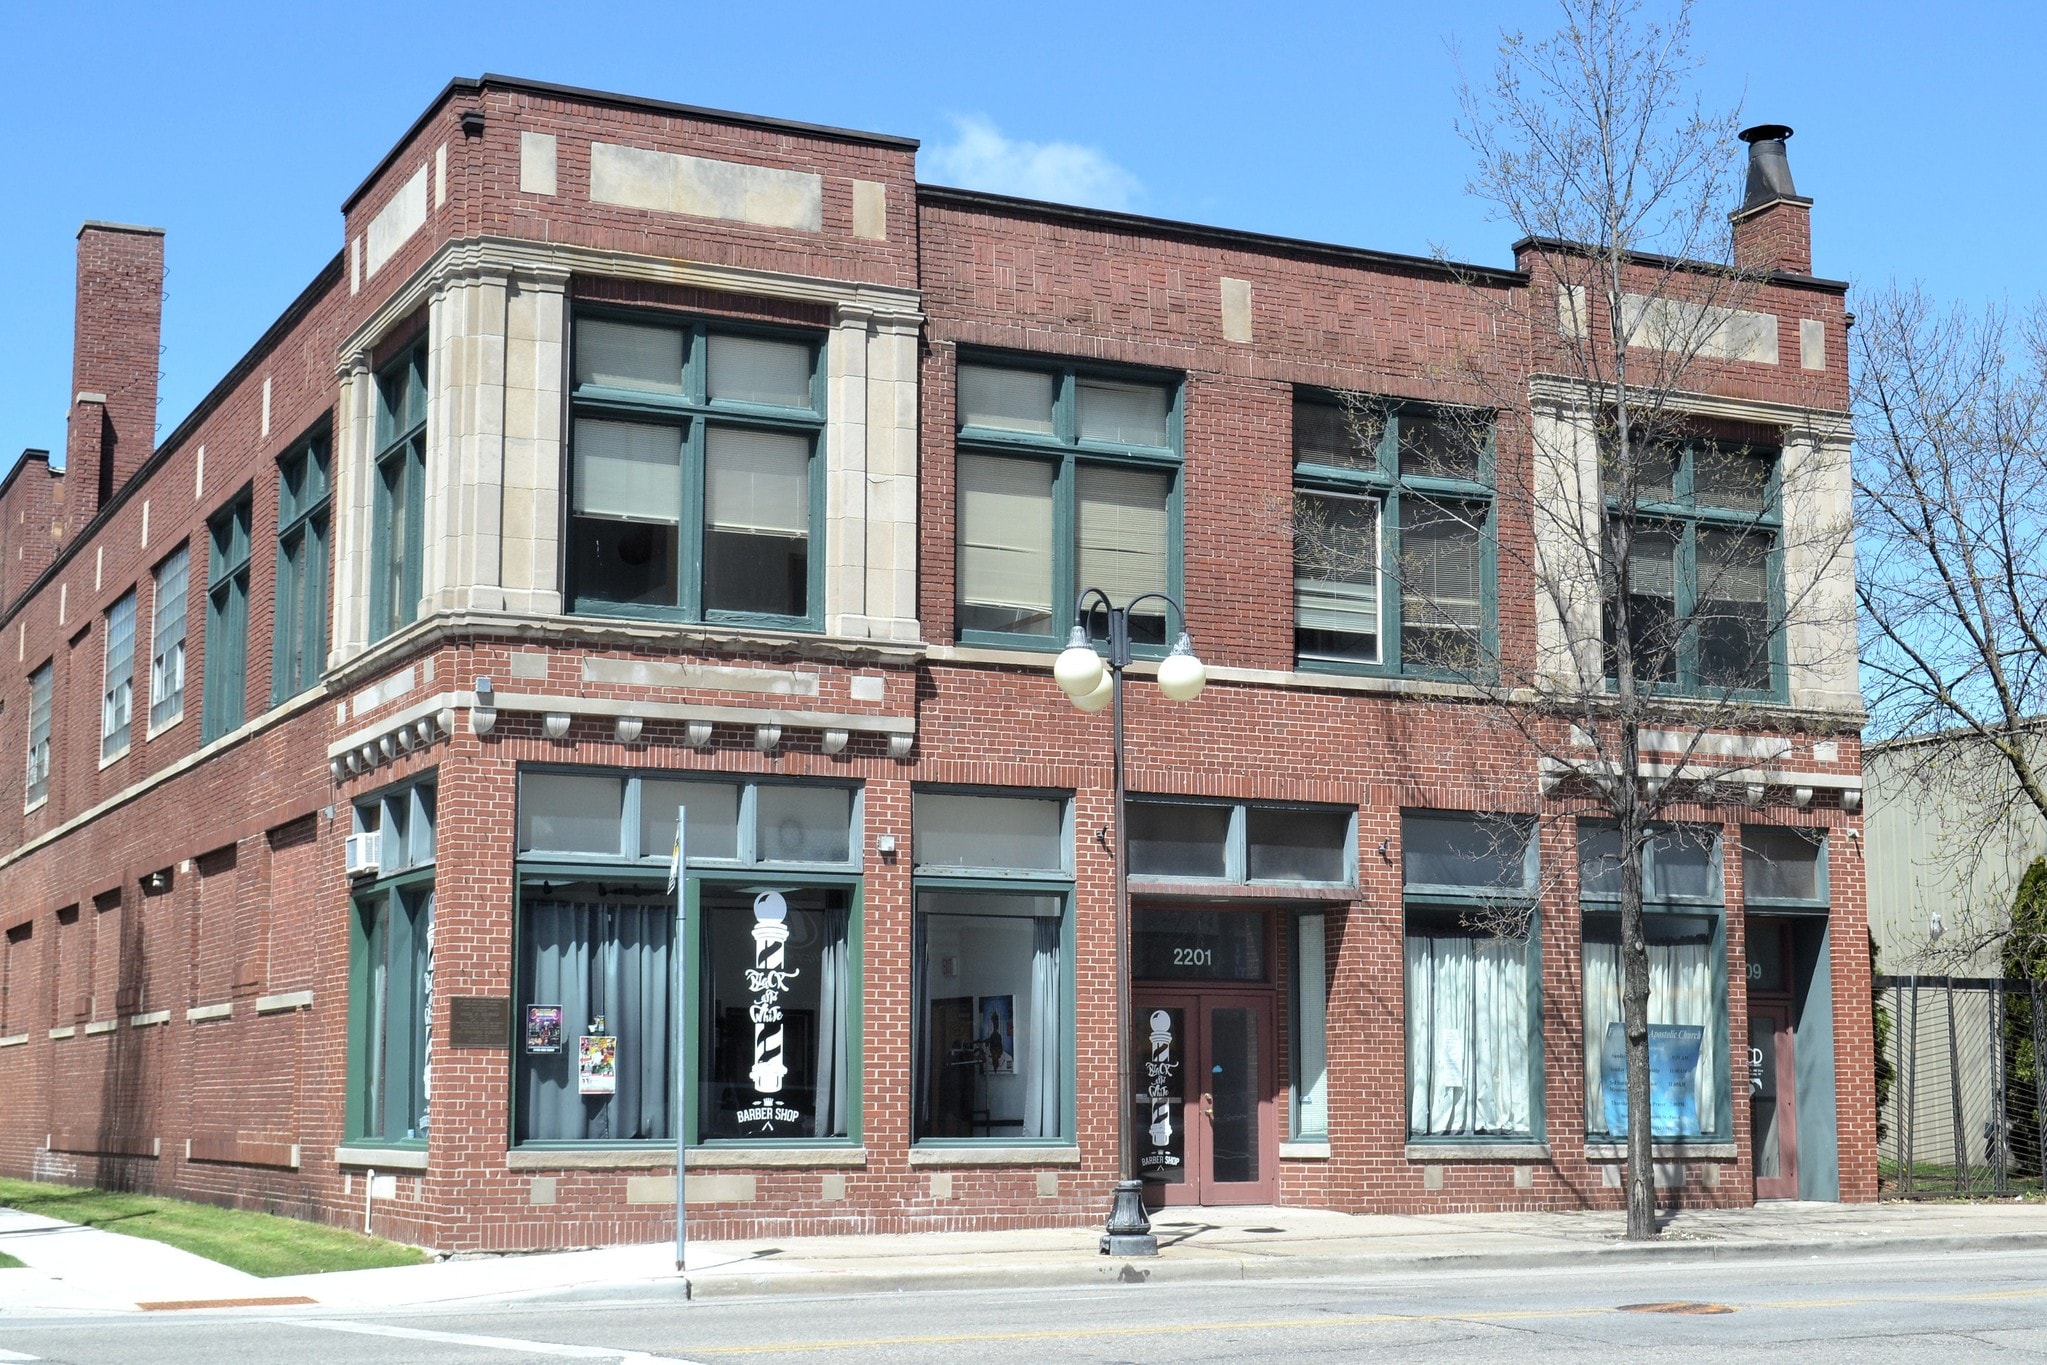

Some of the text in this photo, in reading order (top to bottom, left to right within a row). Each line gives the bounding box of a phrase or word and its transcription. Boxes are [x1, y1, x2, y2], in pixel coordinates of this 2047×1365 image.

[1173, 948, 1211, 966] 2201
[1648, 1029, 1702, 1040] Apostolic Church
[737, 1107, 799, 1123] BARBER SHOP
[1141, 1155, 1180, 1166] BARBER SHOP
